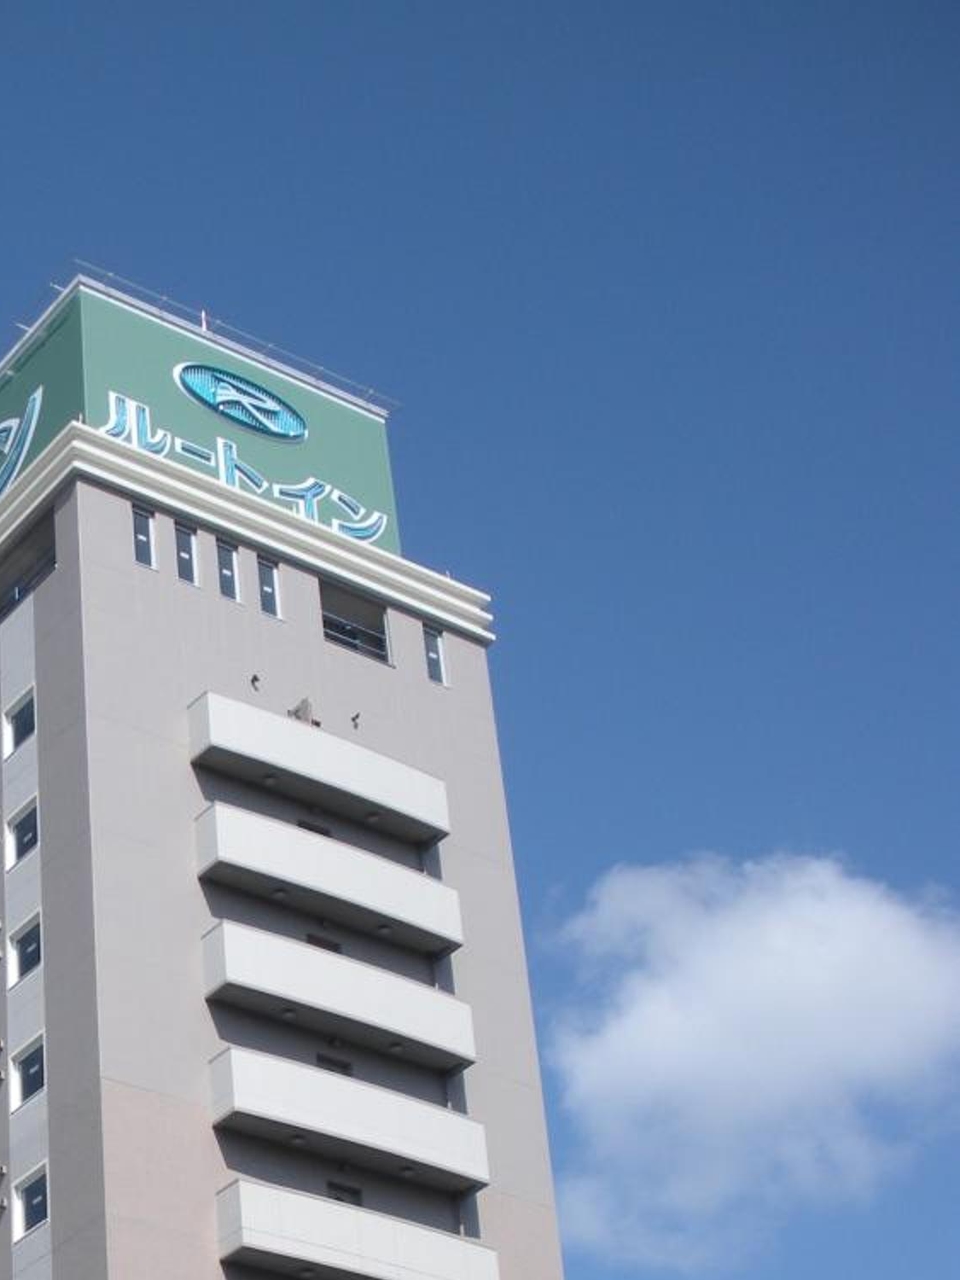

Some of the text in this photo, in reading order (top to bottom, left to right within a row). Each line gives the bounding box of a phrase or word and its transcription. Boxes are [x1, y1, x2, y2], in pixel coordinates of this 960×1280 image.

[97, 390, 388, 543] ルートイン
